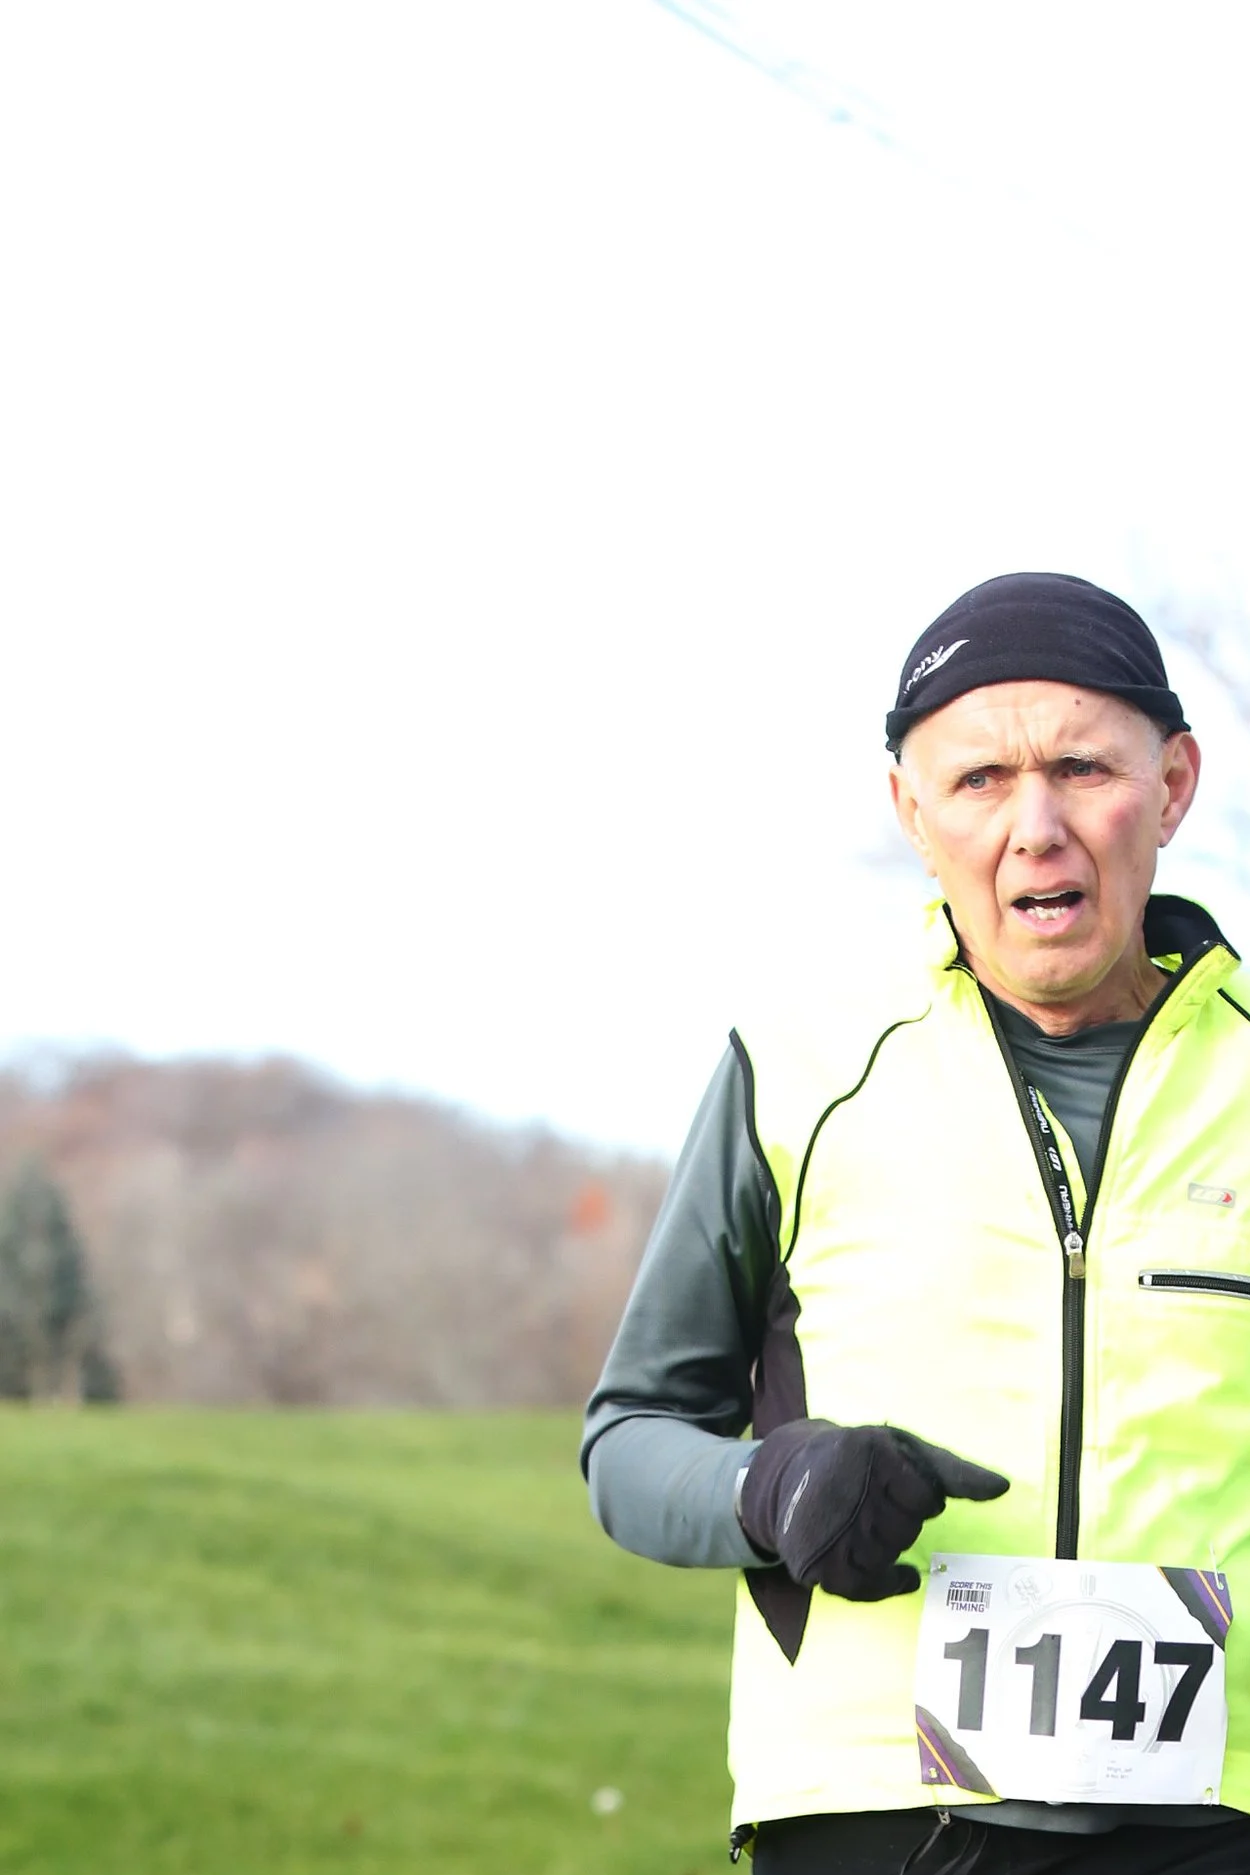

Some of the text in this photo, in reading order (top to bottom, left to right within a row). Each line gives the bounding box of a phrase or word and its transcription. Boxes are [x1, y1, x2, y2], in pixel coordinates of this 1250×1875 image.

[950, 1581, 993, 1590] SCORE THIS
[950, 1602, 985, 1613] TIMING
[944, 1628, 1214, 1742] 1147
